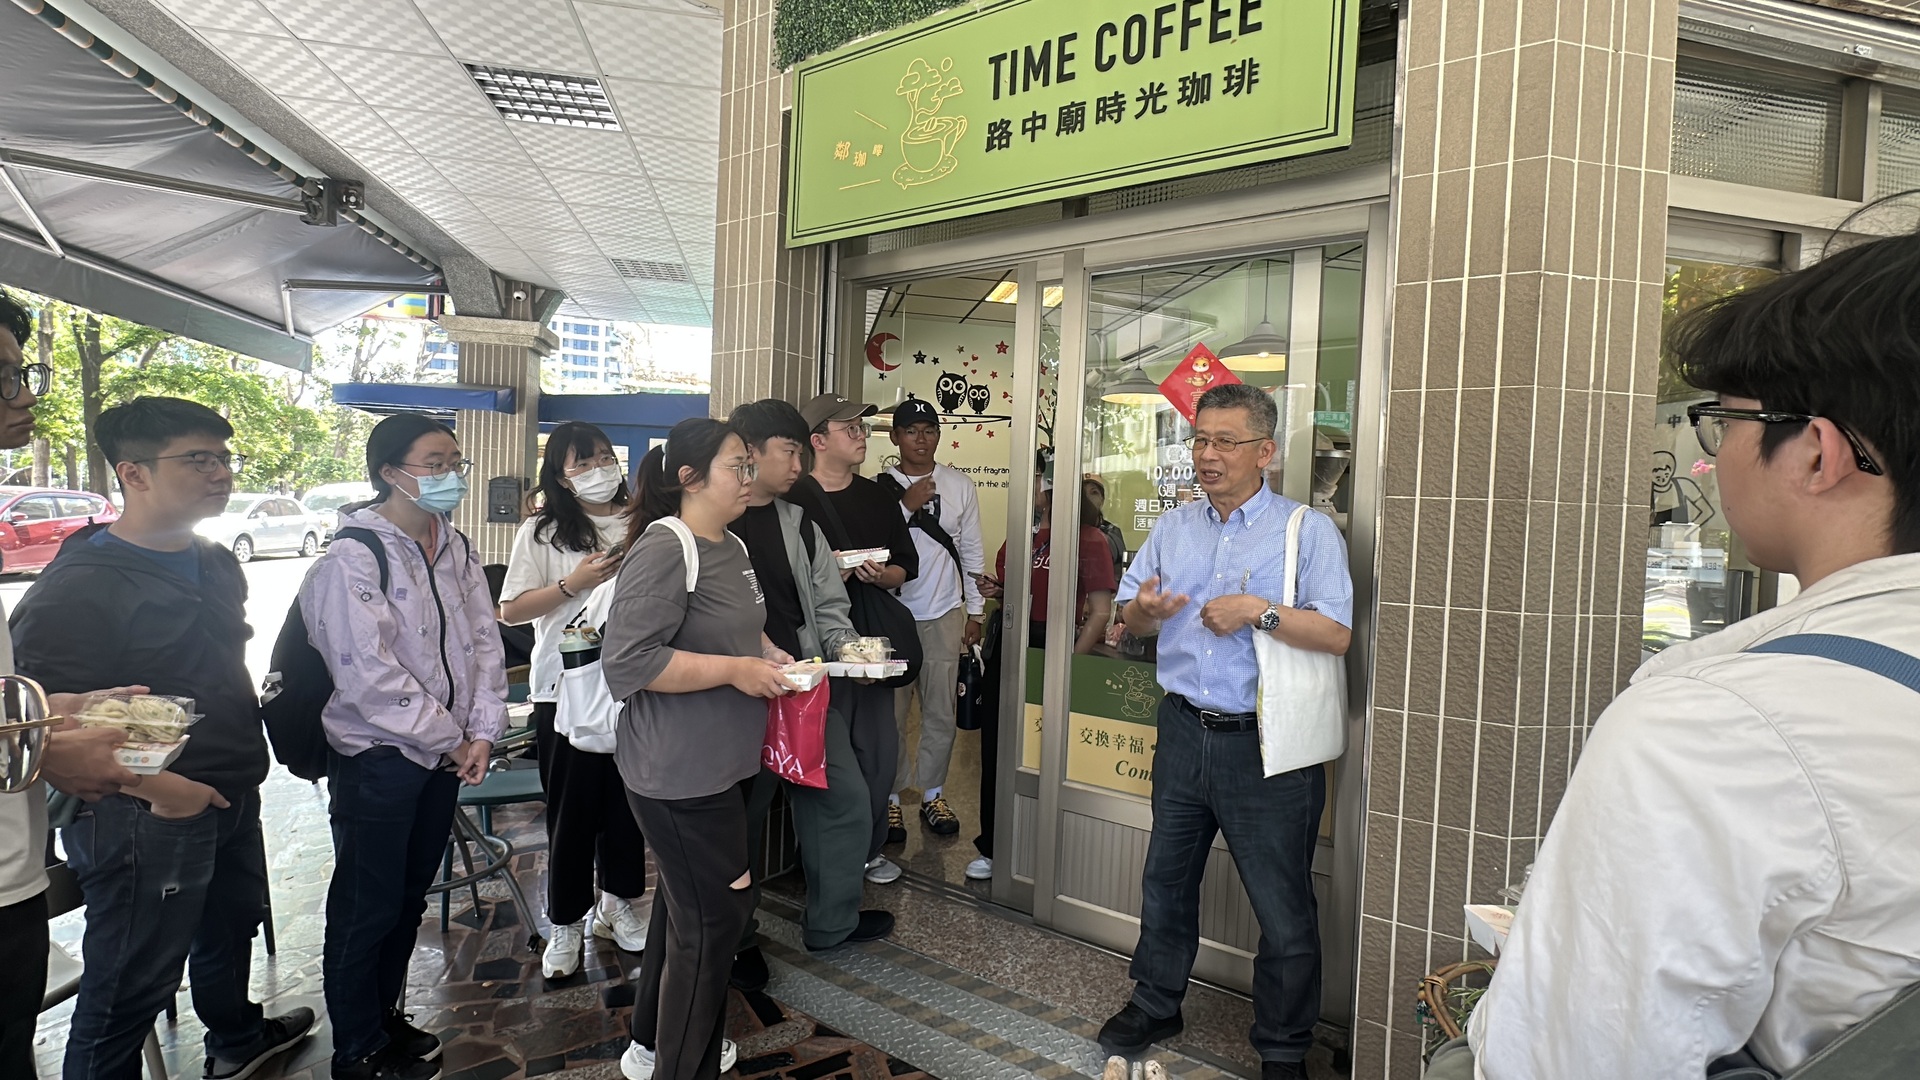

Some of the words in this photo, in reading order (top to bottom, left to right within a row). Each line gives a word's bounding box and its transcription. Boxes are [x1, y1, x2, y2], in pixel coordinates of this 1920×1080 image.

[988, 32, 1078, 101] TIME
[1094, 0, 1263, 73] COFFEE
[985, 57, 1260, 153] 路中廟時光珈琲
[1145, 465, 1196, 481] 10:00
